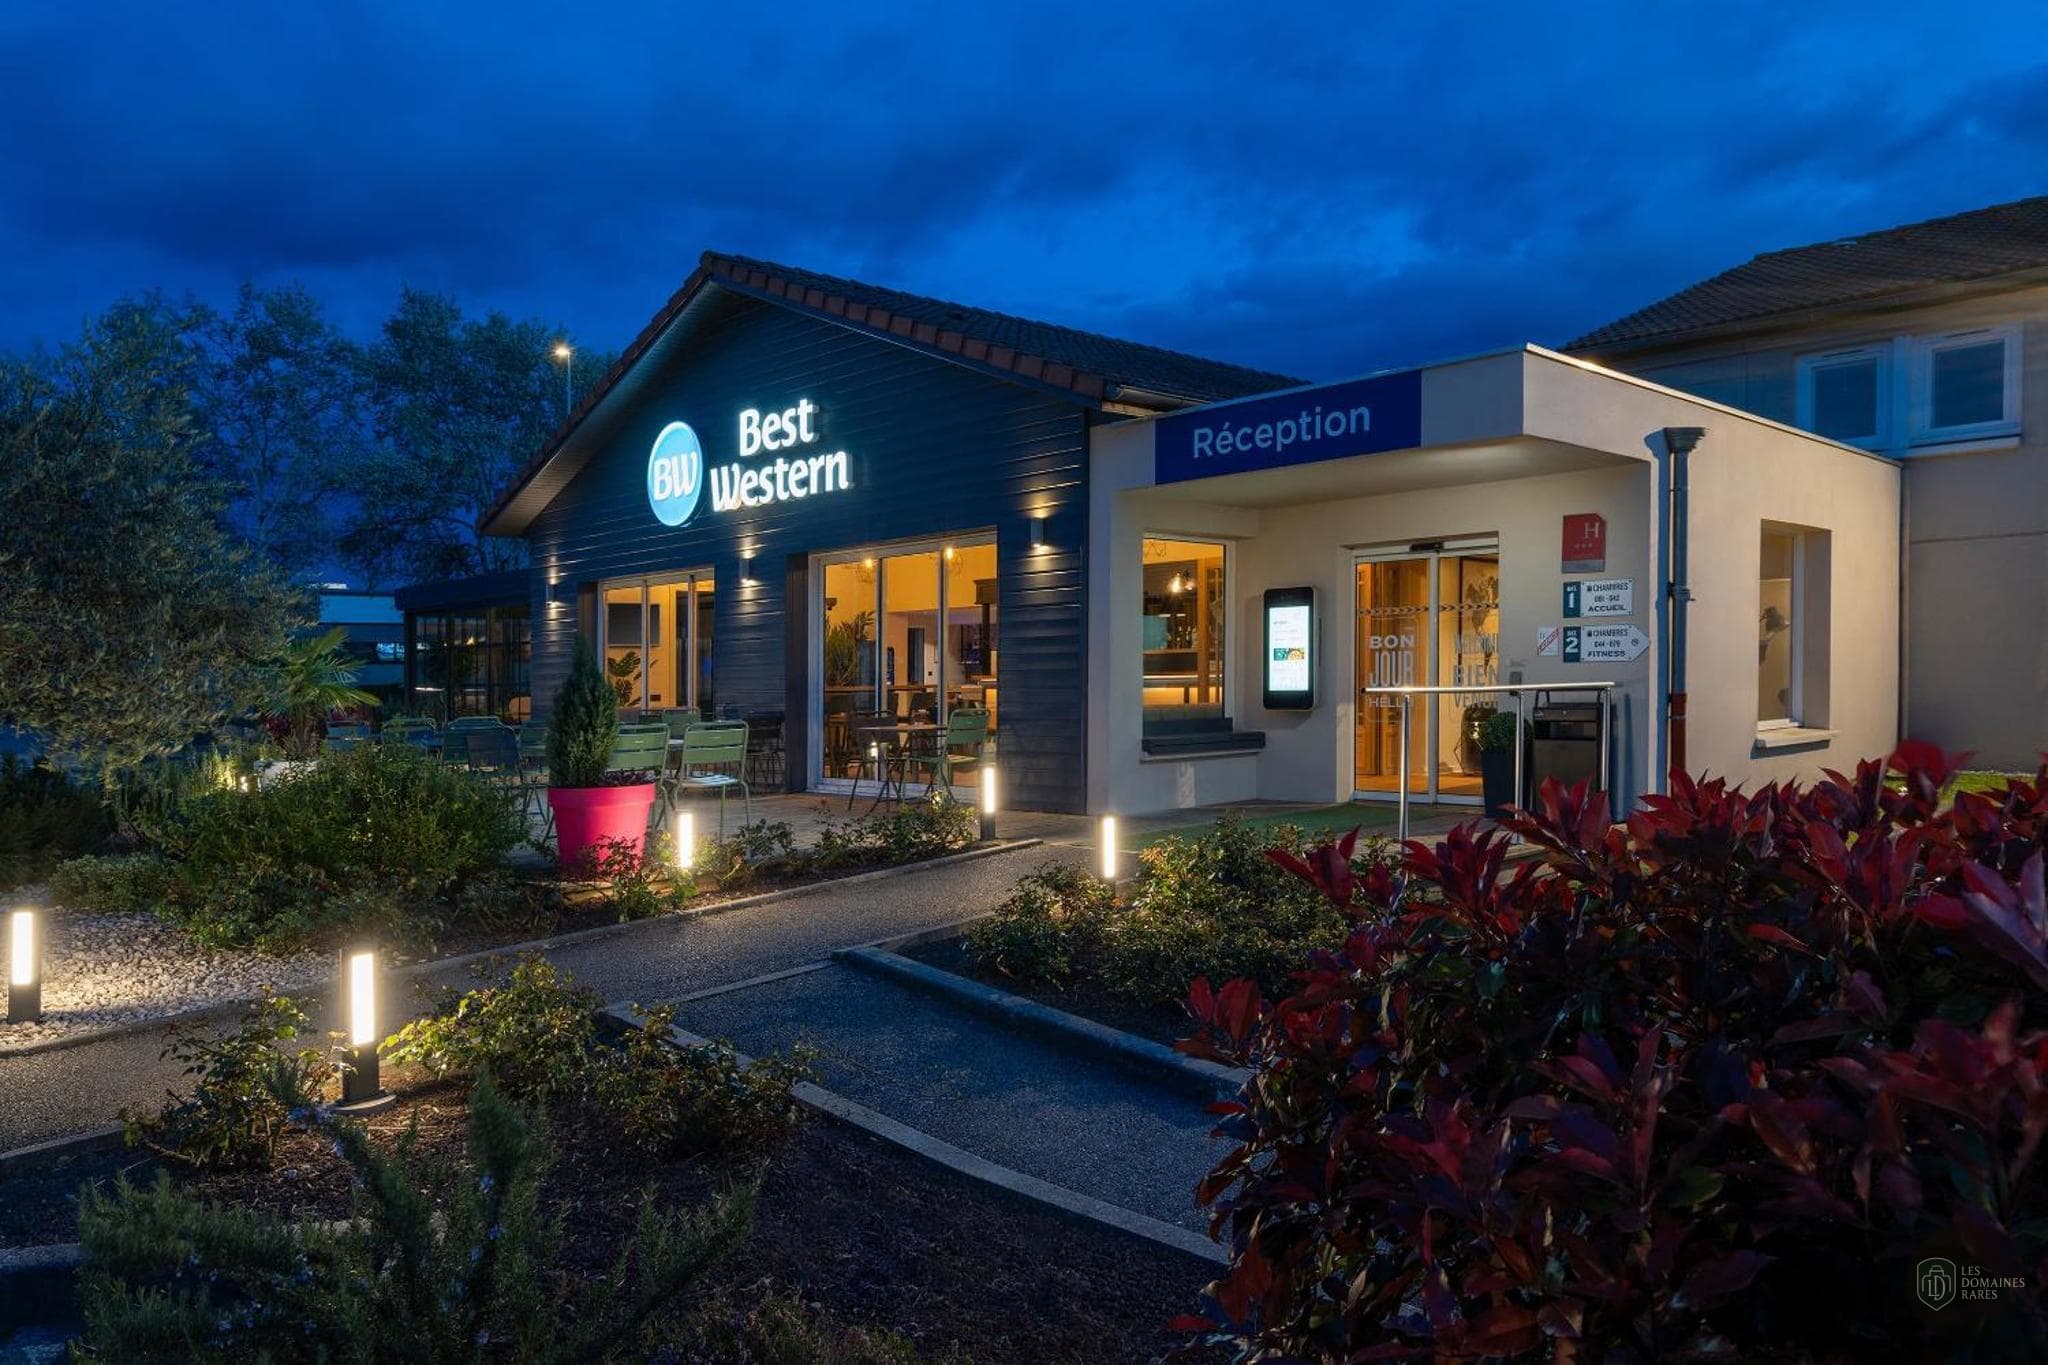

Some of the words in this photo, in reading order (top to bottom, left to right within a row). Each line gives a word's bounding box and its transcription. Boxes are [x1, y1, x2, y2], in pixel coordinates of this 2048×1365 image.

[738, 398, 815, 457] Best
[1193, 405, 1371, 458] Réception
[652, 451, 698, 502] BW
[709, 451, 850, 512] Western
[1584, 521, 1600, 539] H
[1567, 592, 1575, 608] 1
[1588, 604, 1627, 612] ACCUEIL
[1592, 628, 1628, 637] CHAMBRES
[1370, 635, 1415, 650] BON
[1565, 637, 1579, 653] 2
[1587, 650, 1626, 658] FITNESS
[1369, 651, 1413, 688] JOUR
[1369, 695, 1412, 709] HELL
